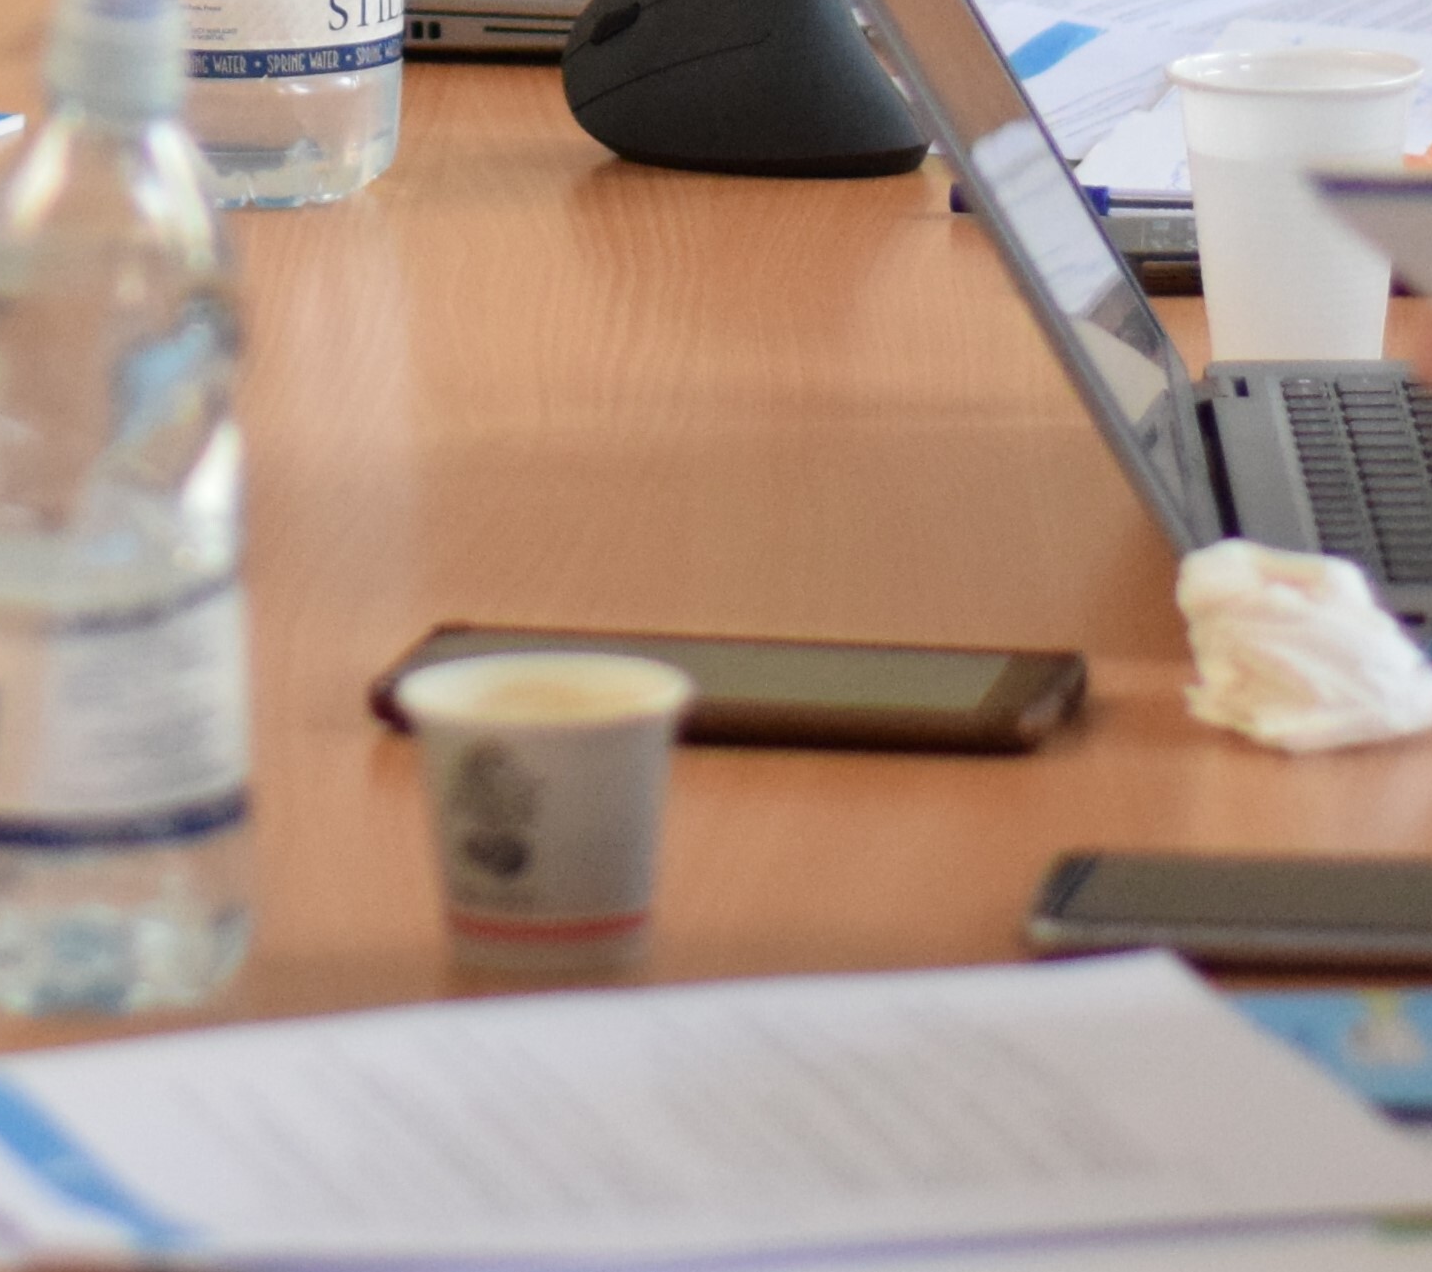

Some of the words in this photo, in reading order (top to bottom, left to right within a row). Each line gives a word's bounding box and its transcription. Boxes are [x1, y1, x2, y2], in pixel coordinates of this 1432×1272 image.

[212, 54, 246, 74] WATER
[266, 52, 305, 74] SPRING
[309, 50, 339, 70] WATER
